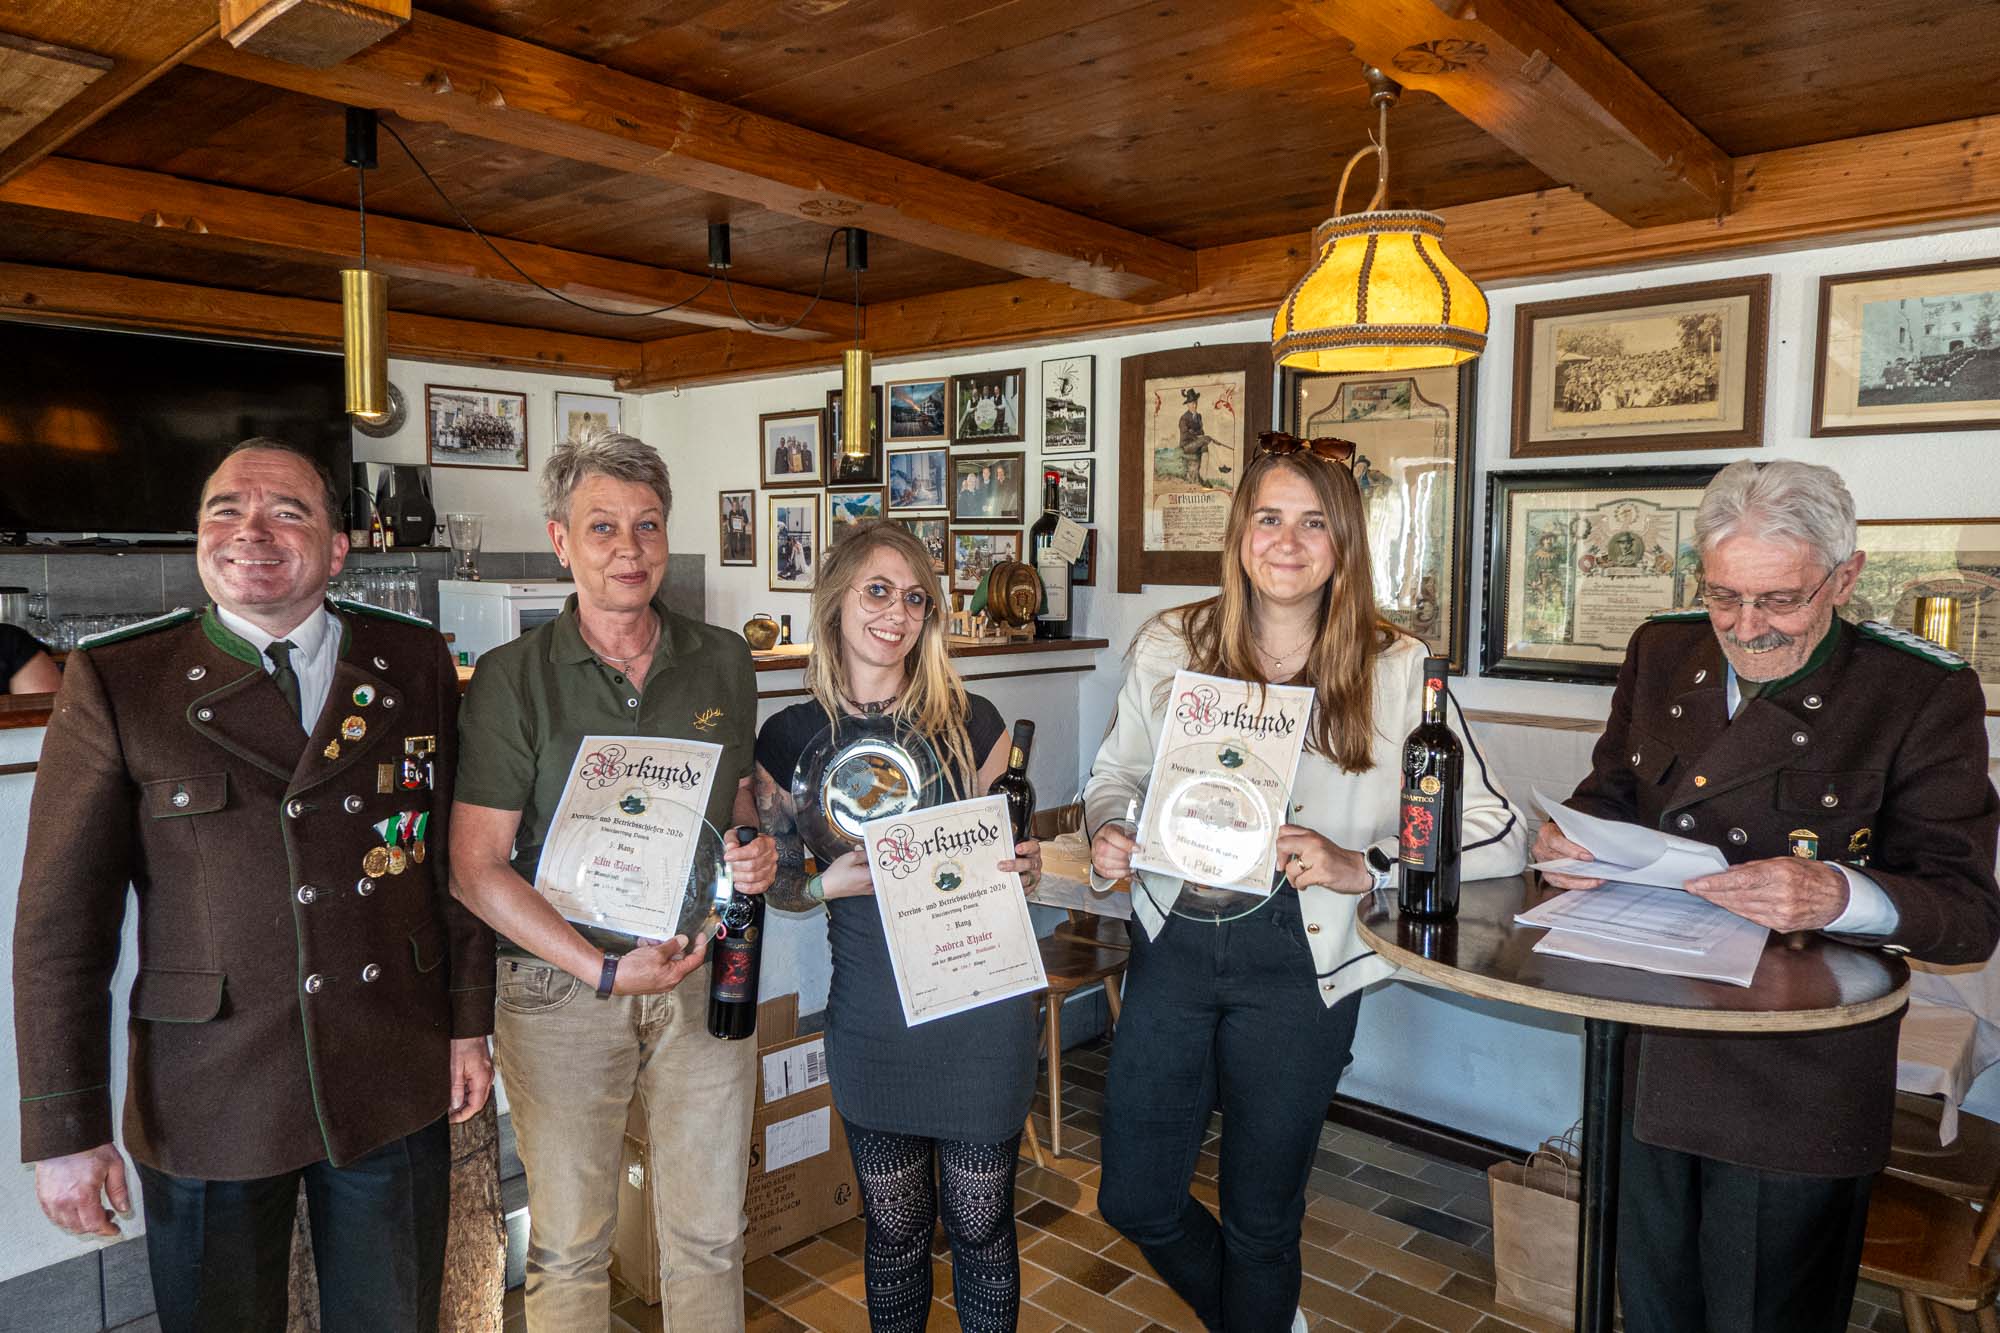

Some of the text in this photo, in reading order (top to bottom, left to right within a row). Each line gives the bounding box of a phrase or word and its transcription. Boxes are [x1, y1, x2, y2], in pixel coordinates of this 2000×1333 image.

[1176, 683, 1295, 740] Urkunde
[580, 743, 701, 790] Urkunde
[666, 827, 684, 838] 2026
[877, 818, 999, 879] Urkunde
[897, 883, 1007, 919] Vereins- und Betriebsschießen 2026
[954, 919, 972, 930] Rang
[934, 939, 965, 956] Andrea
[966, 930, 993, 946] Thaler
